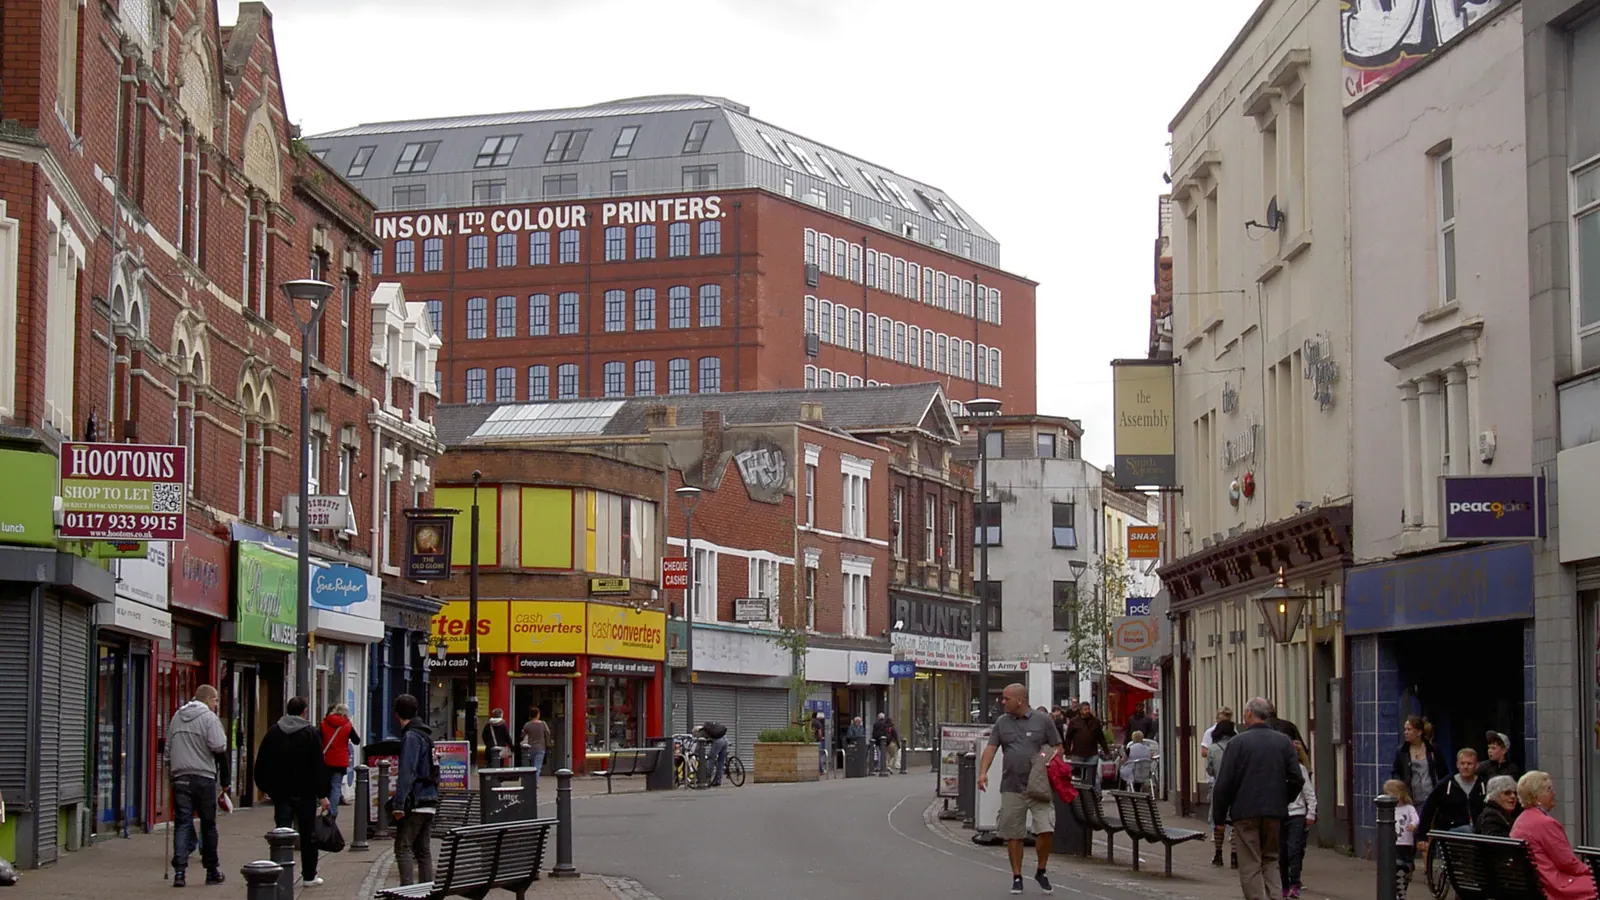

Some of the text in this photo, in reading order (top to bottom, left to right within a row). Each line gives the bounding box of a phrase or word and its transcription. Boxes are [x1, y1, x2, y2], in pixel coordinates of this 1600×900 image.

[490, 205, 586, 232] COLOUR
[602, 195, 727, 225] PRINTERS.
[1136, 389, 1151, 404] the
[1119, 408, 1170, 433] Assembly
[71, 447, 175, 478] HOOTONS
[64, 486, 150, 500] SHOP TO LET
[1, 522, 25, 533] lunch
[66, 513, 177, 531] 0117 933 9915
[89, 530, 153, 538] www.hootons.co.uk
[663, 561, 688, 572] CHEQUE
[665, 575, 688, 586] CASHE
[334, 577, 363, 597] Ryder
[1129, 603, 1150, 615] pds
[516, 612, 543, 624] cash
[895, 598, 971, 637] BLUNTS
[513, 622, 583, 634] converters
[448, 658, 469, 667] cash
[520, 659, 576, 668] cheques cashed
[997, 662, 1018, 670] Army
[497, 792, 519, 801] Litter
